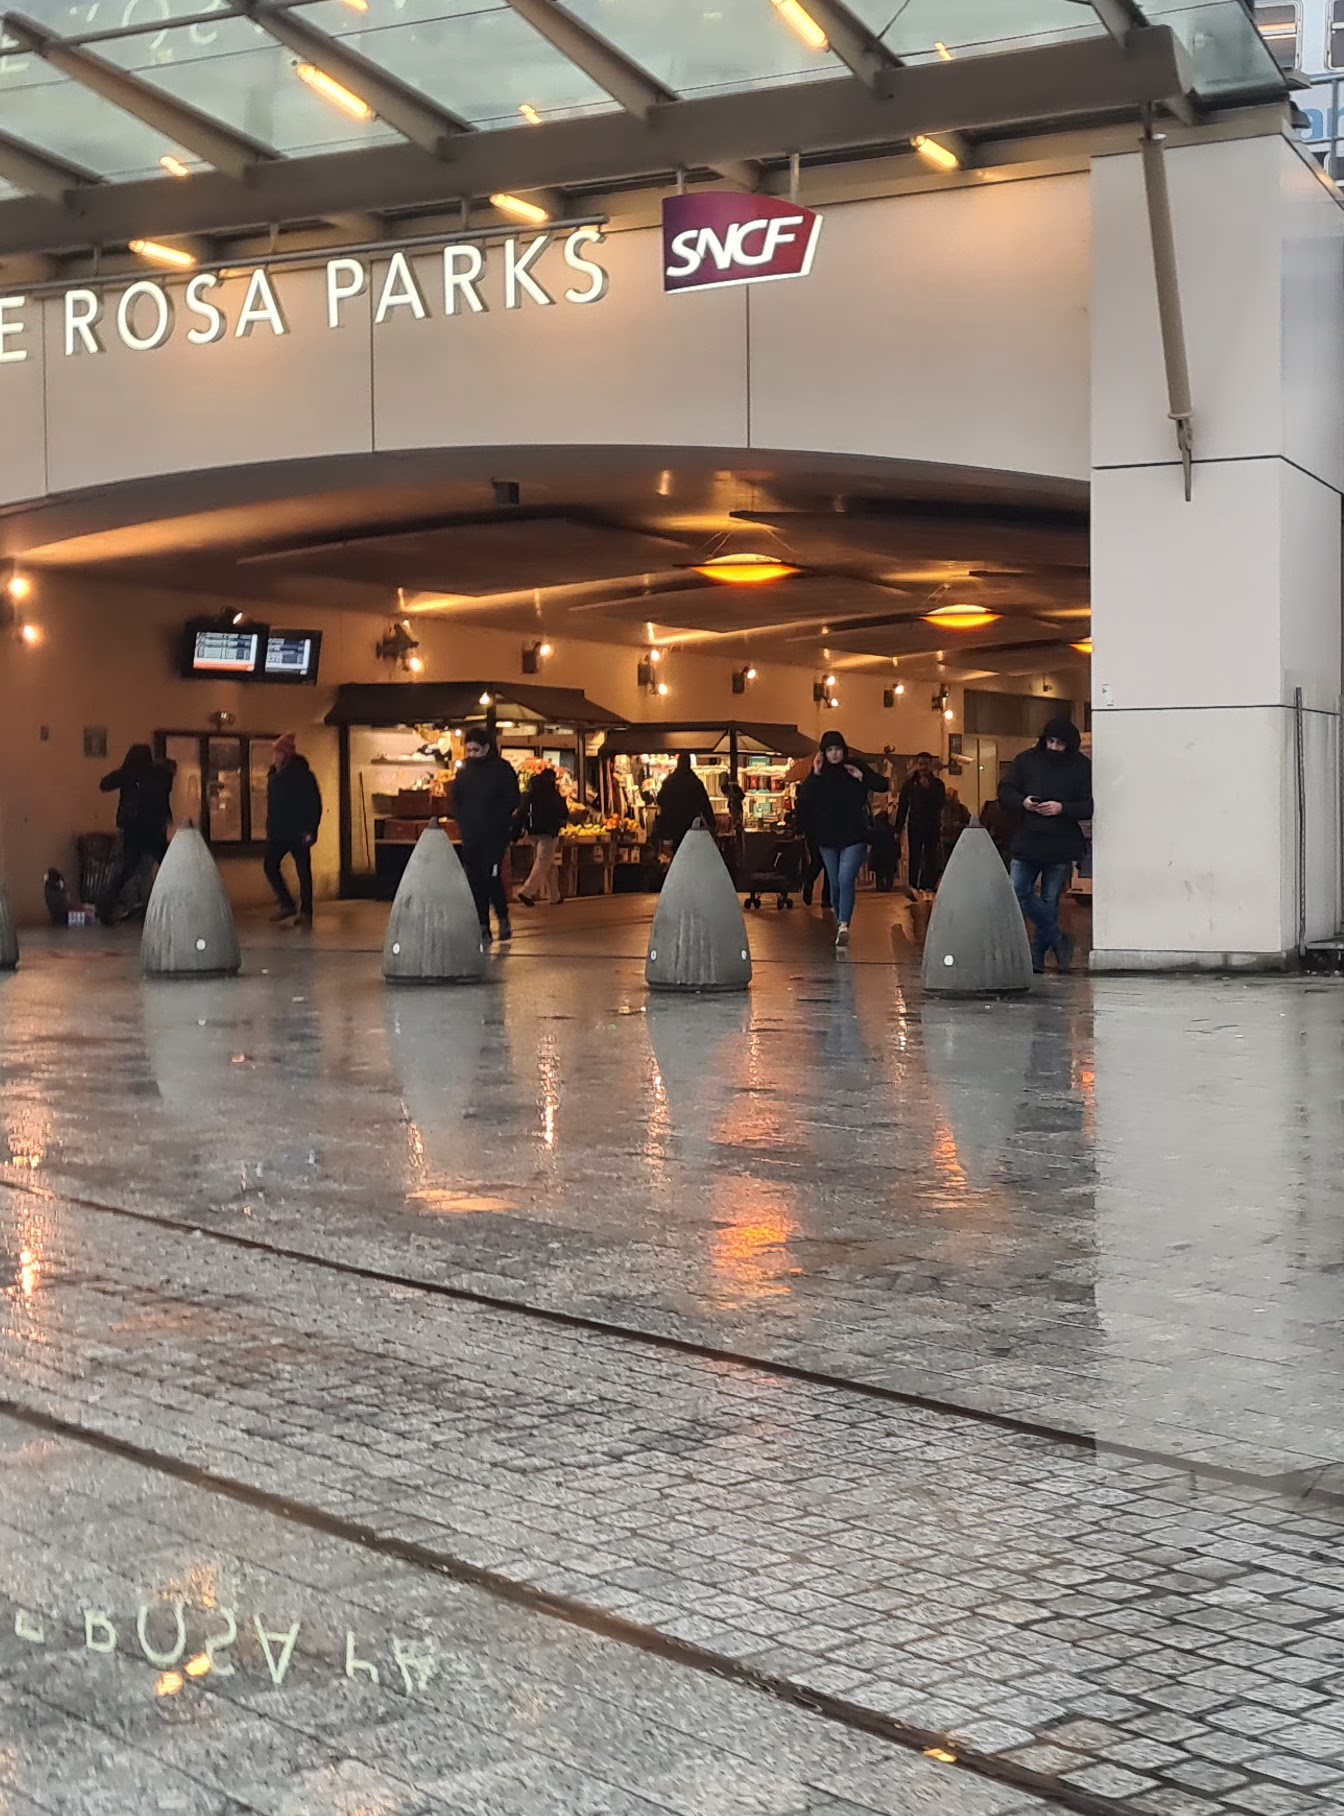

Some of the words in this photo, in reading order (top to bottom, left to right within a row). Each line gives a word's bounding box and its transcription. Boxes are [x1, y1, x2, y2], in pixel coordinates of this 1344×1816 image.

[64, 267, 290, 357] ROSA
[326, 229, 608, 329] PARKS
[665, 214, 804, 279] SNCF
